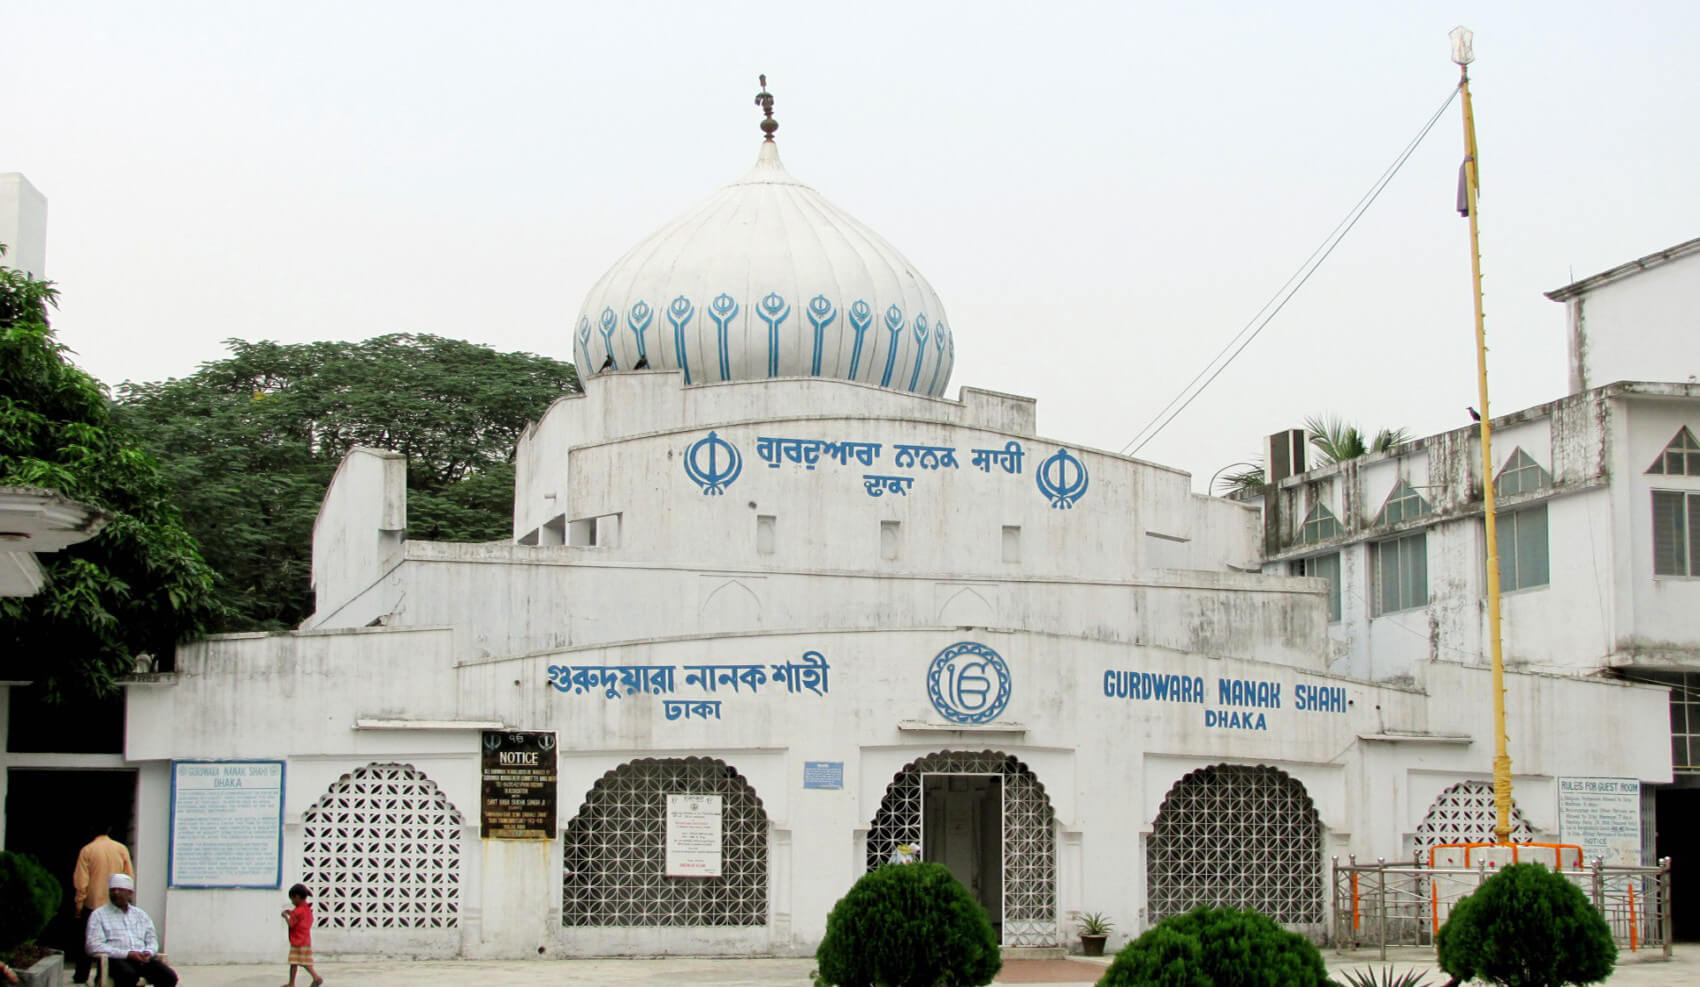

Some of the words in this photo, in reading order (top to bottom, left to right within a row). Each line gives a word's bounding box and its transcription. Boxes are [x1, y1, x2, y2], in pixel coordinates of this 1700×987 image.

[893, 444, 960, 470] ਨਾਨਕ
[971, 440, 1025, 474] ਸ਼ਾਹੀ
[547, 664, 676, 699] গুরুদুয়ারা
[683, 664, 767, 693] নানক
[771, 650, 831, 697] শাহী
[1104, 670, 1204, 703] GURDWARA
[1219, 678, 1281, 708] NANAK
[1296, 685, 1346, 712] SHAHI
[662, 699, 722, 721] ঢাকা
[1205, 710, 1267, 730] DHAKA
[500, 752, 539, 764] NOTICE
[214, 778, 242, 787] DHAKA
[1561, 781, 1584, 791] RULES
[1585, 782, 1597, 791] FOR
[1598, 782, 1618, 792] GUEST
[1620, 783, 1638, 793] ROOM
